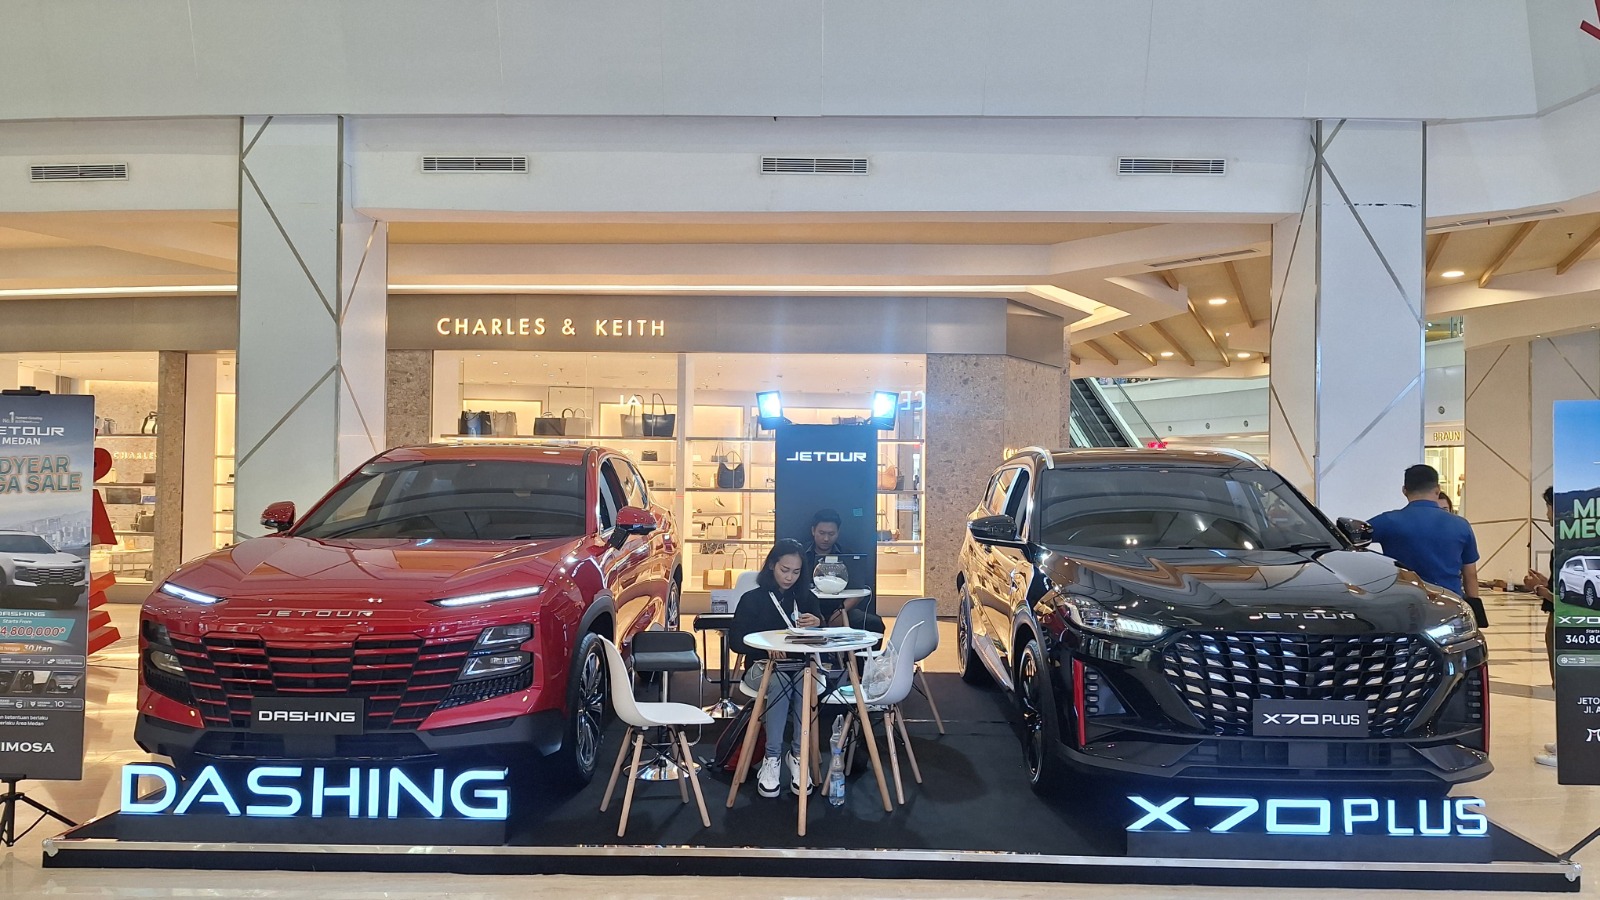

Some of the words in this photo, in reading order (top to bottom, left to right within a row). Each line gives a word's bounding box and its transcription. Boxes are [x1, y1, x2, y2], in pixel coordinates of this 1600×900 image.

[437, 318, 546, 335] CHARLES
[562, 318, 576, 336] &
[596, 319, 665, 336] KEITH
[2, 437, 41, 445] MEDAN
[1433, 431, 1461, 442] BRAUN
[786, 451, 867, 462] JETOUR
[26, 472, 82, 492] SALE
[1249, 612, 1356, 620] JETOUR
[1558, 616, 1600, 624] X70
[54, 700, 65, 708] 10
[258, 710, 356, 723] DASHING
[1262, 713, 1319, 725] X70
[1322, 714, 1360, 726] PLUS
[119, 765, 509, 820] DASHING
[1126, 795, 1331, 836] X70
[1343, 797, 1490, 837] PLUS
